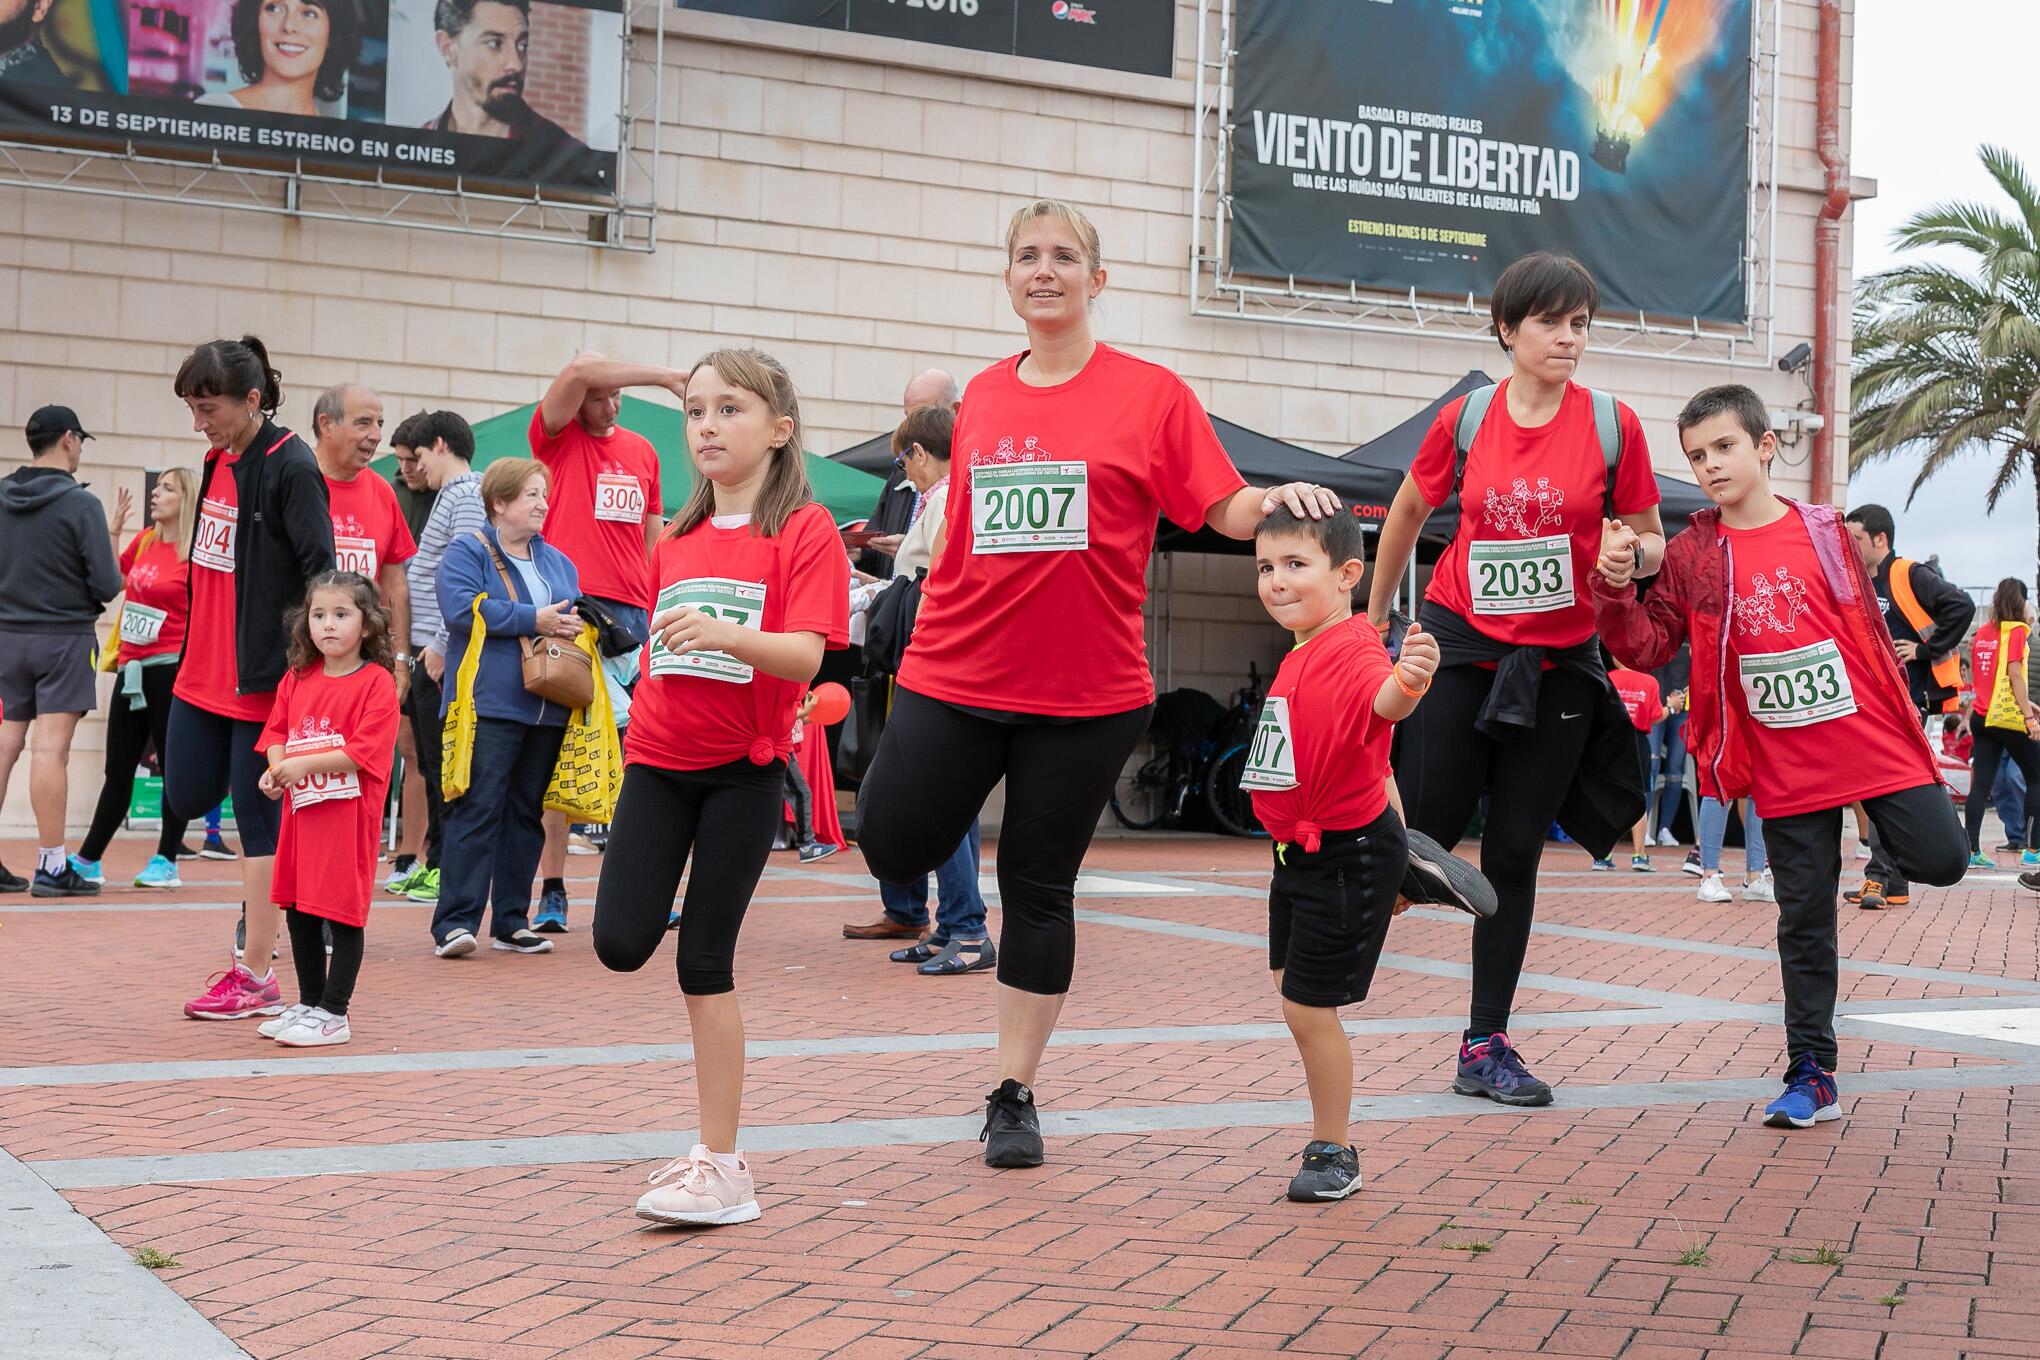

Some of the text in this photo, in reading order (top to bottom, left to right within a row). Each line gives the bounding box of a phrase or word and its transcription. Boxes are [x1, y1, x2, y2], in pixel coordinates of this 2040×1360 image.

[50, 105, 456, 165] 13 DE SEPTIEMBRE ESTRENO EN CINES
[1358, 105, 1483, 134] BASADA EN HECHOS REALES
[1253, 110, 1580, 201] VIENTO DE LIBERTAD
[1292, 172, 1540, 215] UNA DE LAS HUÍDAS MÁS VALIENTES DE LA GUERRA FRÍA
[1348, 219, 1487, 247] ESTRENO EN CINES 6 DE SEPTIEMBRE
[984, 486, 1076, 531] 2007
[1479, 558, 1563, 597] 2033
[123, 613, 155, 637] 2001
[1752, 663, 1840, 709] 2033
